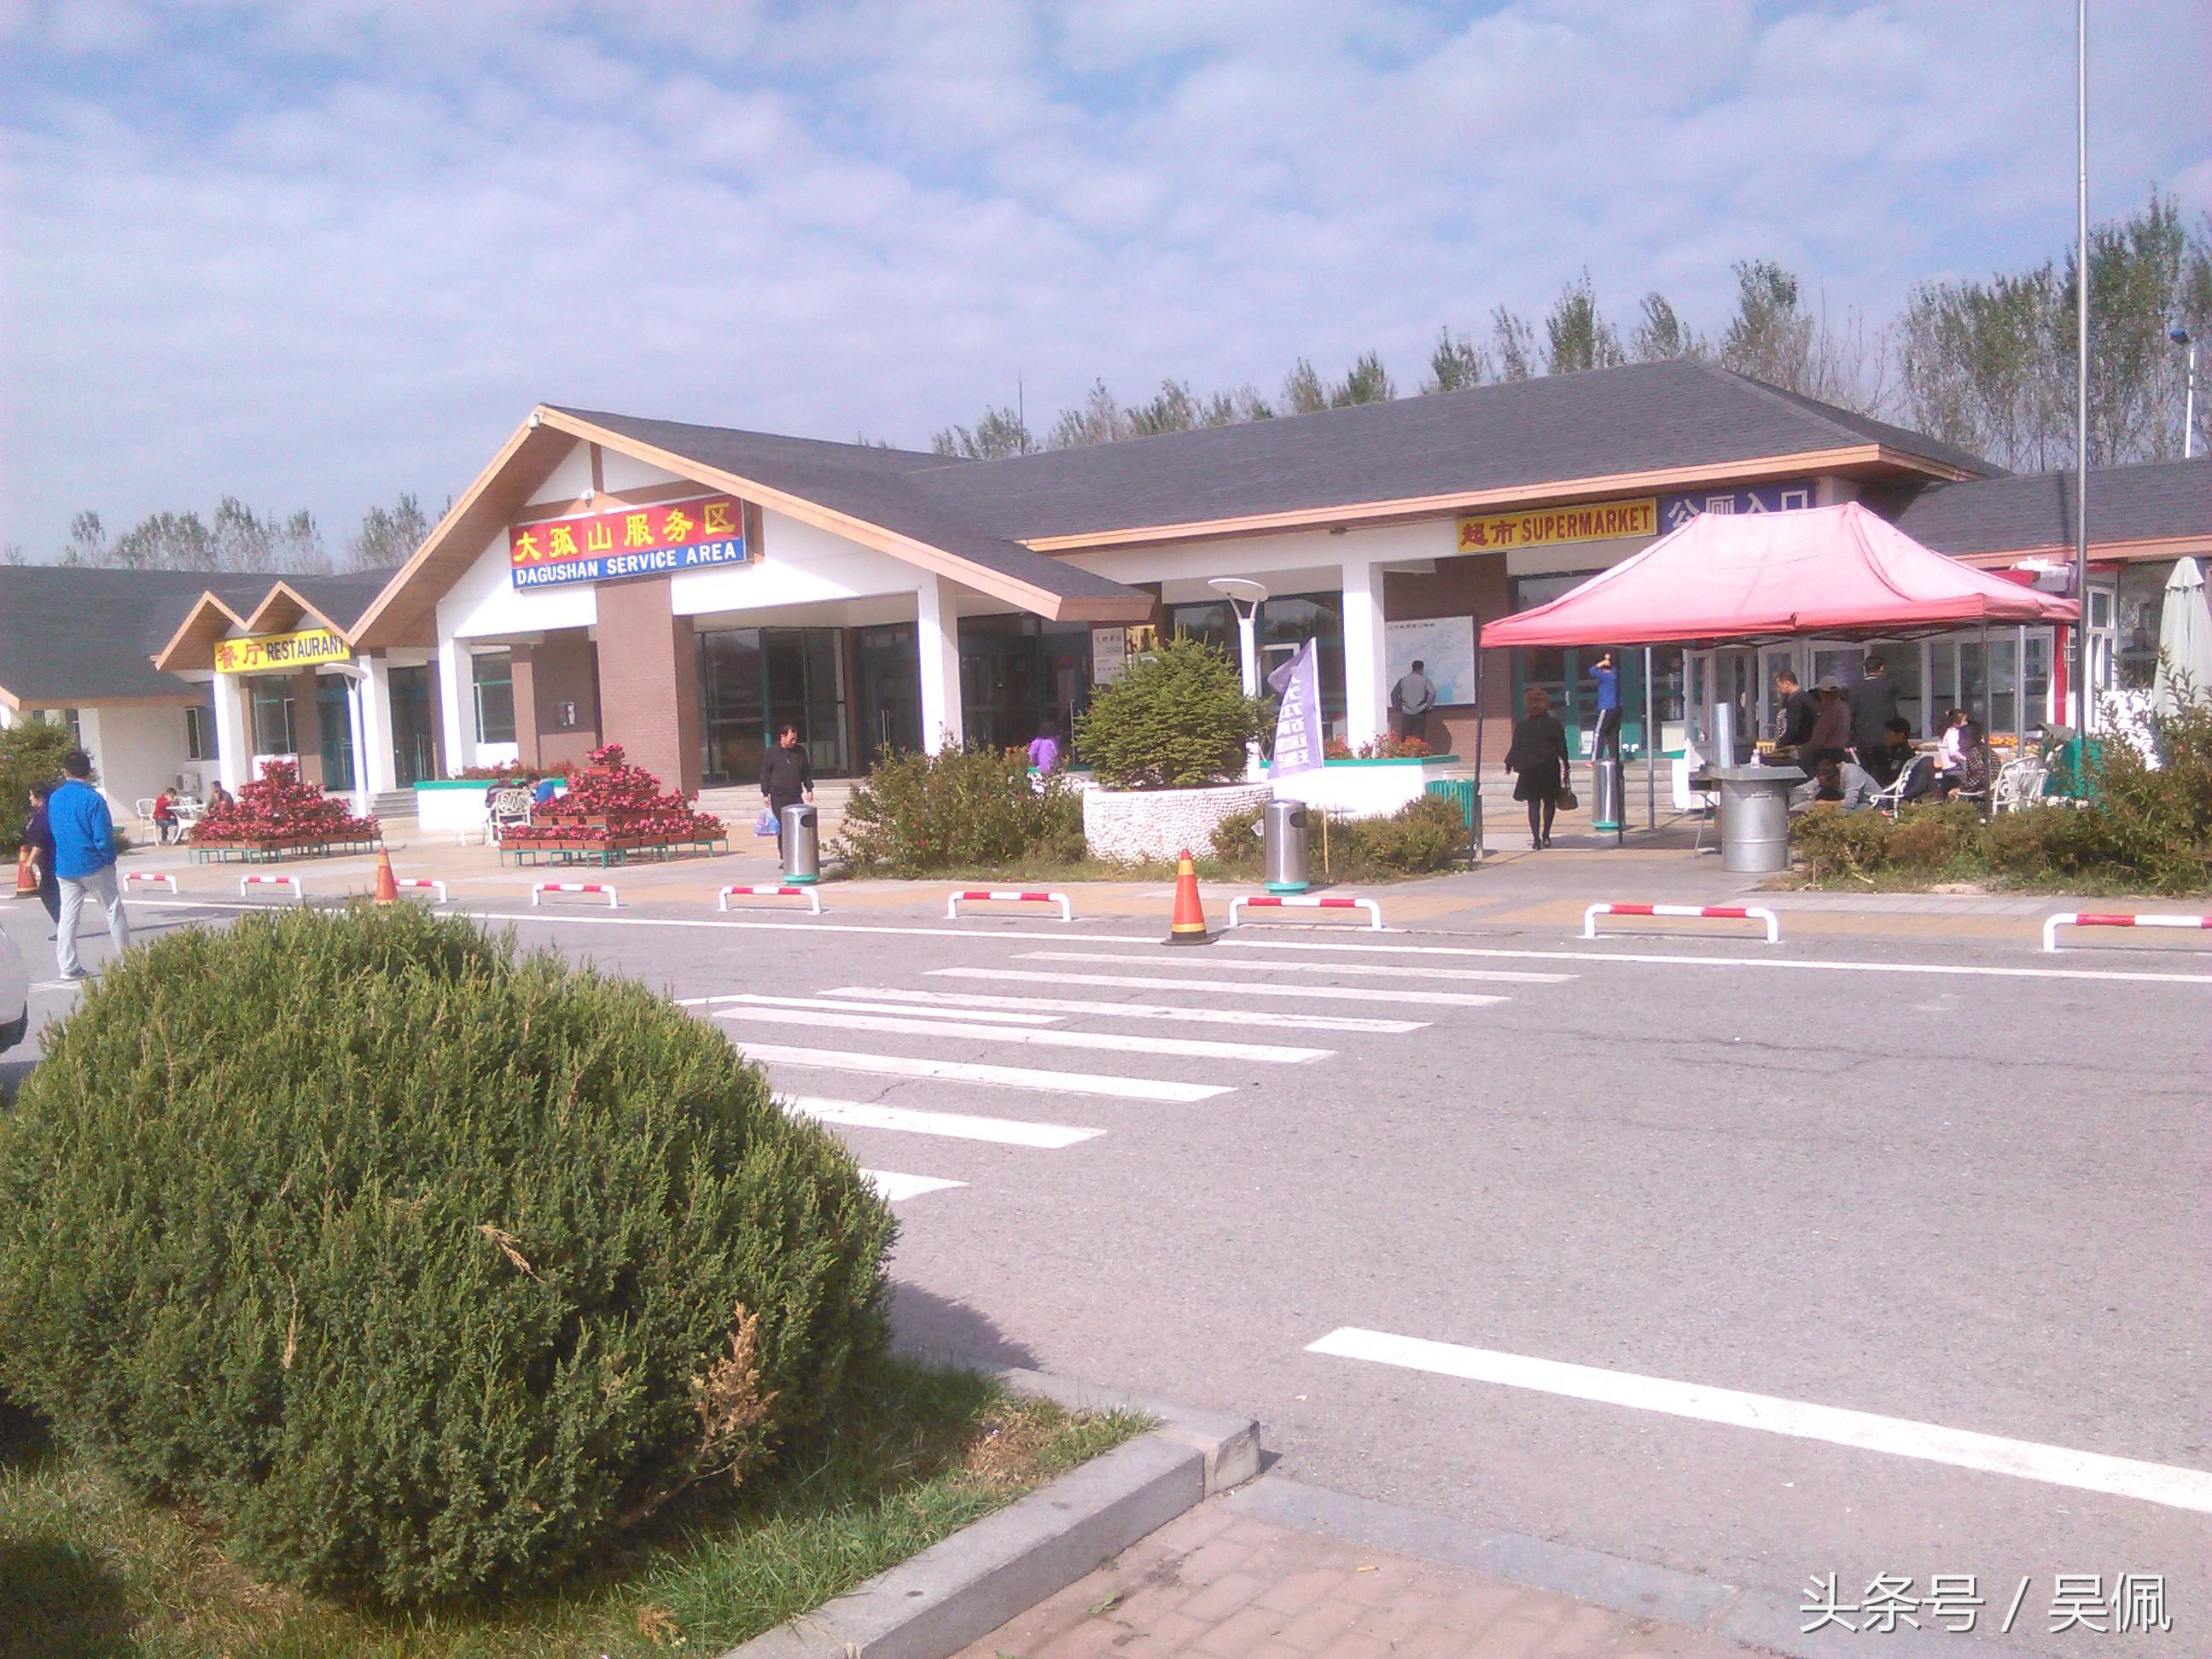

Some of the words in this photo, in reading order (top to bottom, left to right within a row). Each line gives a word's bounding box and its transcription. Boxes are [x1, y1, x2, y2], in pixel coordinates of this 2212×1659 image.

[1460, 520, 1518, 547] 超市
[1522, 505, 1650, 542] SUPERMARKET
[1667, 490, 1808, 527] 公厕入口
[514, 504, 736, 562] 大孤山服务区
[515, 560, 598, 585] DAGUSHAN
[607, 547, 678, 575] SERVICE
[685, 540, 737, 565] AREA
[218, 643, 263, 669] 餐厅
[266, 634, 345, 662] RESTAURANT
